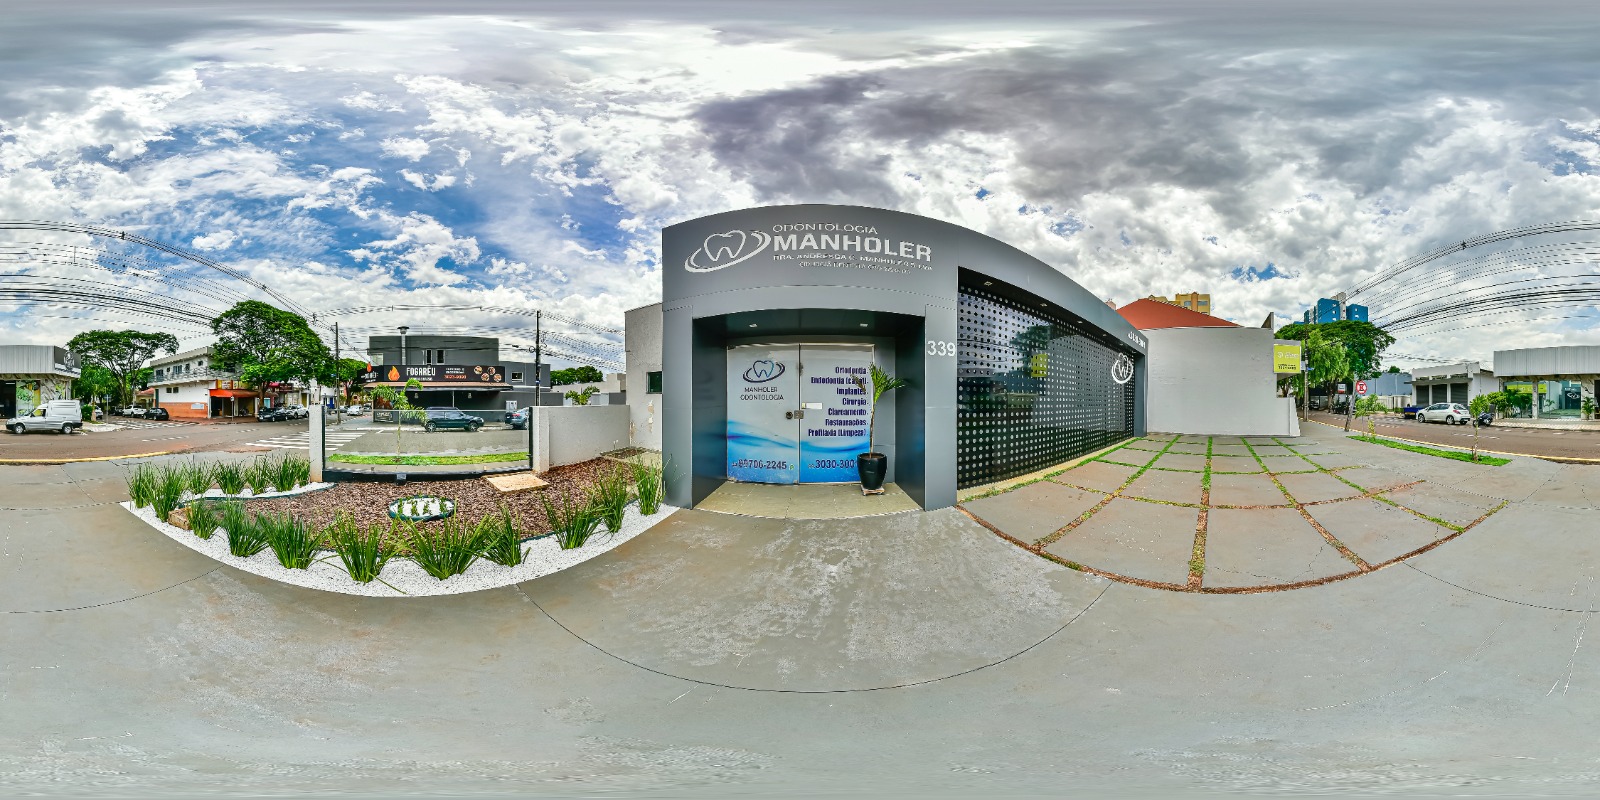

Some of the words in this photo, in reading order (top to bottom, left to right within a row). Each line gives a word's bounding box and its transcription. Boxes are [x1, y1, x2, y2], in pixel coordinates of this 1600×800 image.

[772, 223, 878, 235] ODONTOLOGIA
[773, 233, 932, 263] MANHOLER
[927, 340, 956, 357] 339
[815, 458, 857, 469] 3030-300
